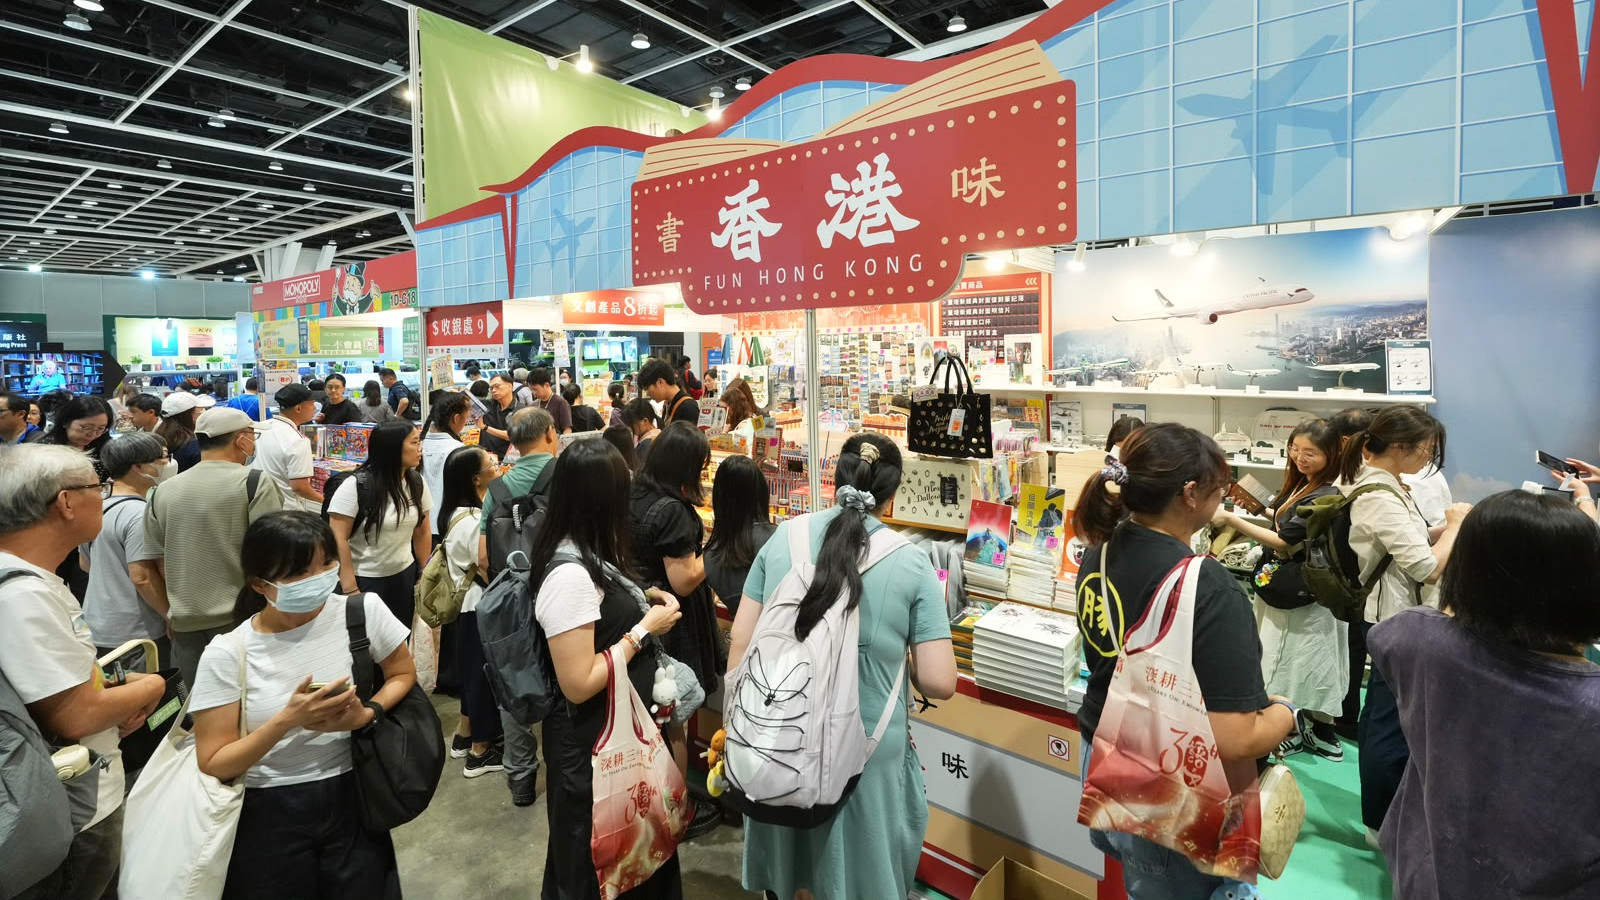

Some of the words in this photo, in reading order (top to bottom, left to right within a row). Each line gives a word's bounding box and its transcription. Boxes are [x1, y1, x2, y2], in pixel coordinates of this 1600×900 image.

[655, 211, 685, 254] 書
[710, 152, 921, 263] 香港
[950, 157, 1006, 206] 味
[704, 271, 743, 290] FUN
[759, 263, 825, 284] HONG
[845, 253, 923, 278] KONG
[284, 278, 320, 297] MONOPOLY
[390, 289, 416, 307] 1D-C18
[431, 320, 439, 336] $
[441, 316, 474, 336] 收銀處
[477, 318, 484, 334] 9
[941, 751, 970, 779] 味
